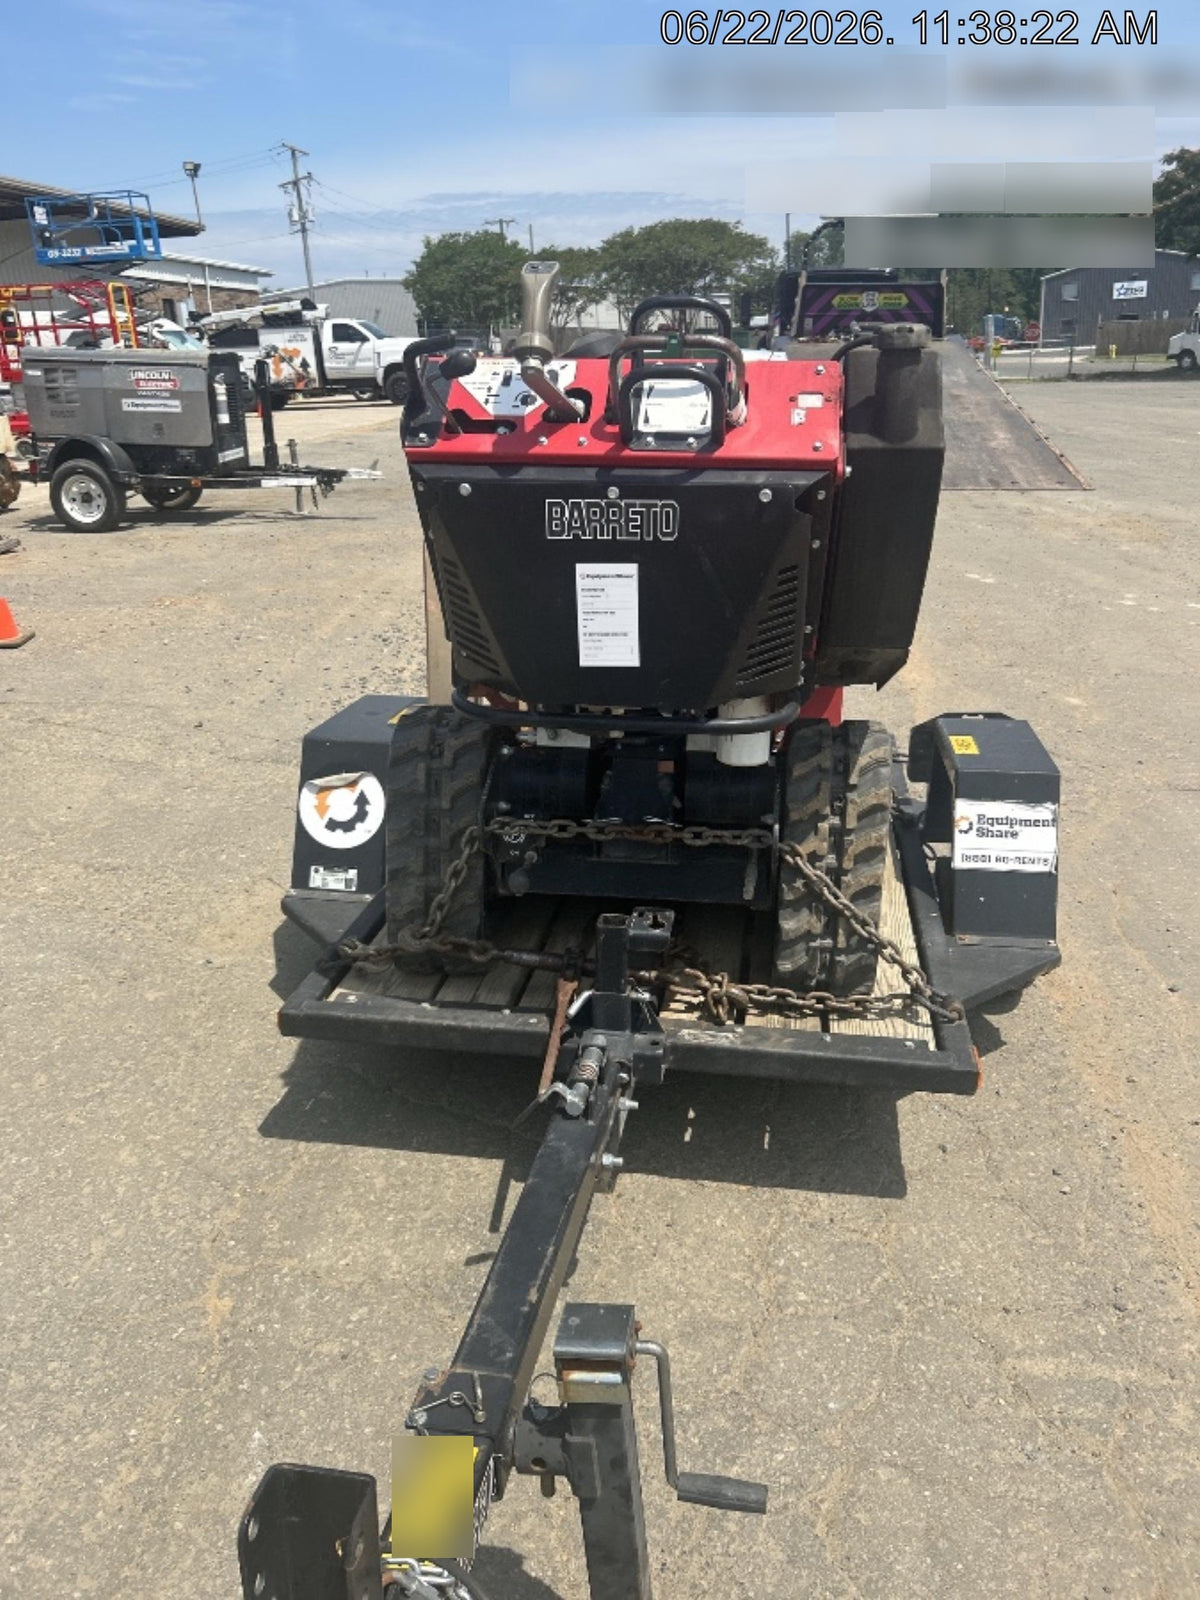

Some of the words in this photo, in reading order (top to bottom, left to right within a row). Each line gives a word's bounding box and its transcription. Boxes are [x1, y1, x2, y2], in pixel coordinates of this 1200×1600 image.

[130, 369, 172, 380] LINCOLN
[545, 499, 680, 541] BARRETO
[976, 814, 1056, 829] Equipment
[976, 827, 1018, 839] Share
